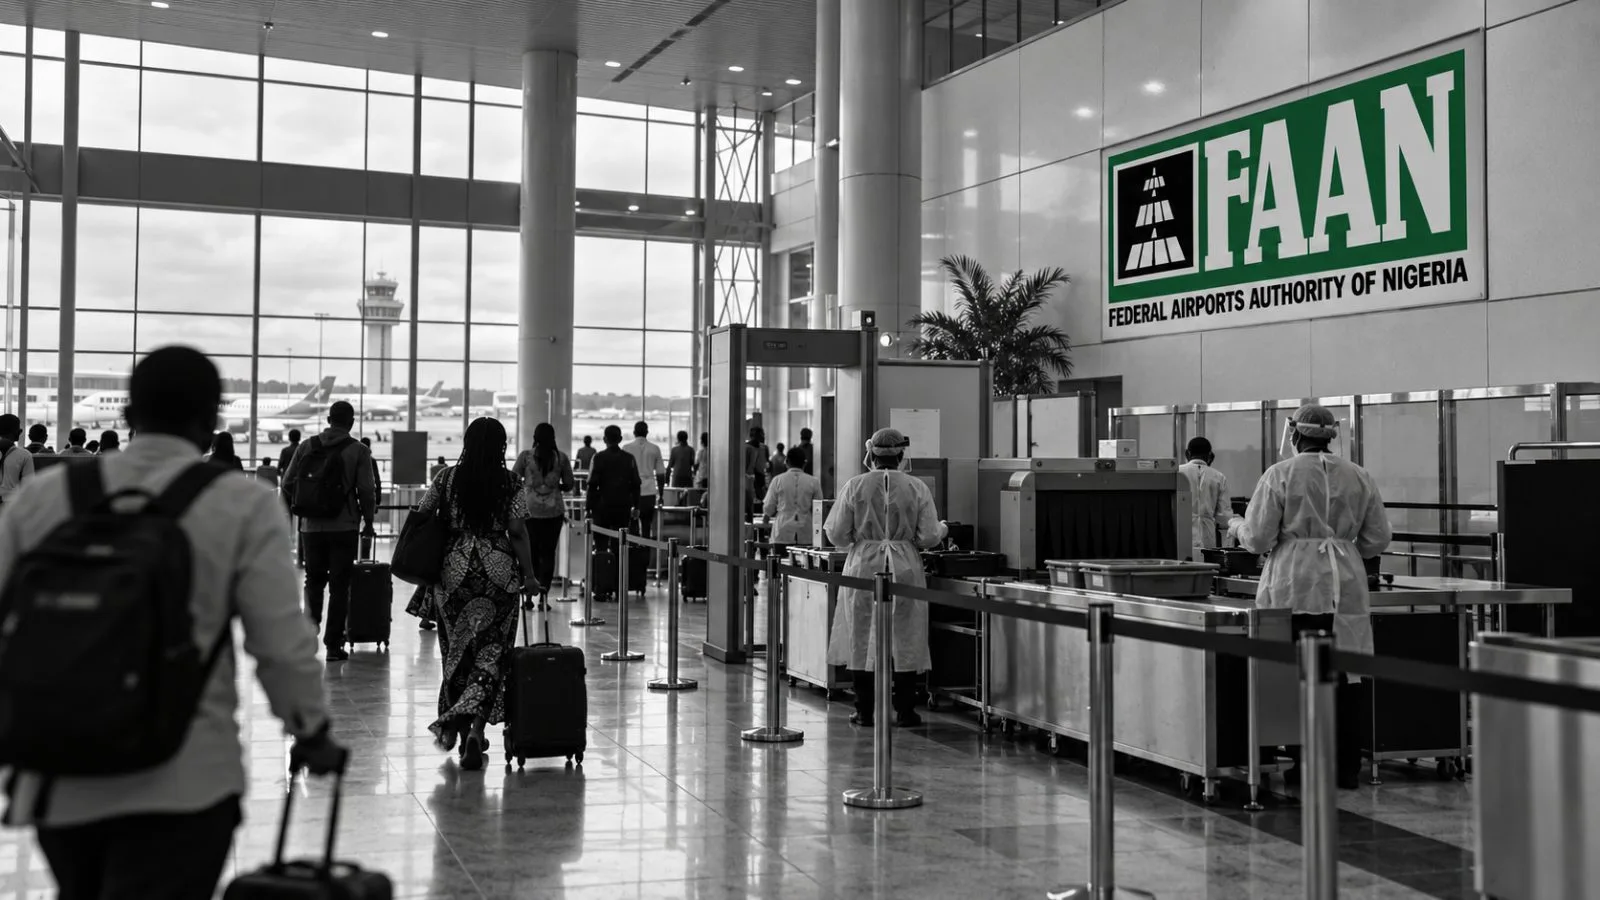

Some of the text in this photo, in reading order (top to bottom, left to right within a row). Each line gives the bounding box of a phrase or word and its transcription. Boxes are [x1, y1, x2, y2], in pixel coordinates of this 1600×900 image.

[1205, 70, 1455, 271] FAAN
[1108, 258, 1469, 327] FEDERAL AIRPORTS AUTHORITY OF NIGERIA
